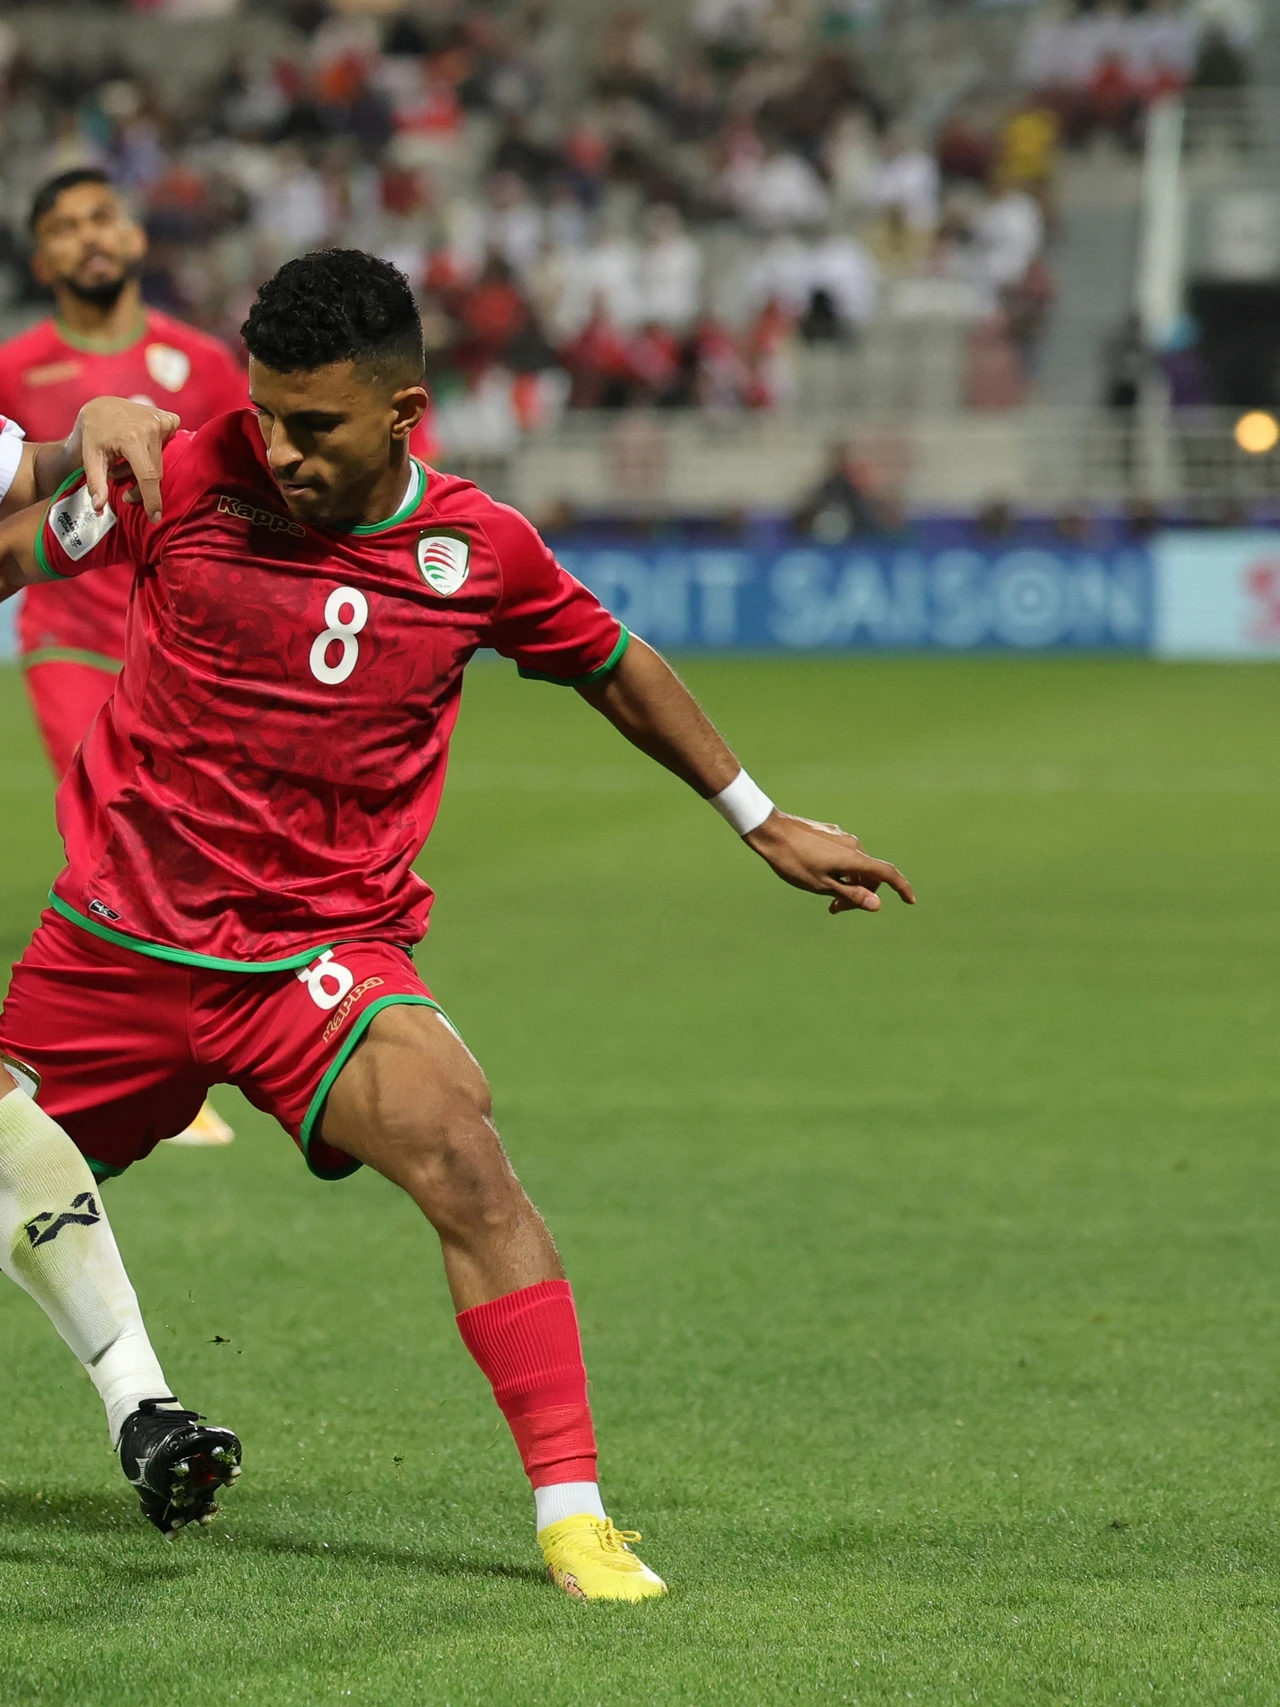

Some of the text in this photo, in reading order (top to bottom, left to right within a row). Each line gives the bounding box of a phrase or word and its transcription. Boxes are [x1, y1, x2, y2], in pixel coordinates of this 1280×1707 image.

[72, 531, 82, 546] CUP
[217, 495, 306, 538] Kappa
[309, 586, 369, 685] 8
[322, 976, 385, 1044] Kappa
